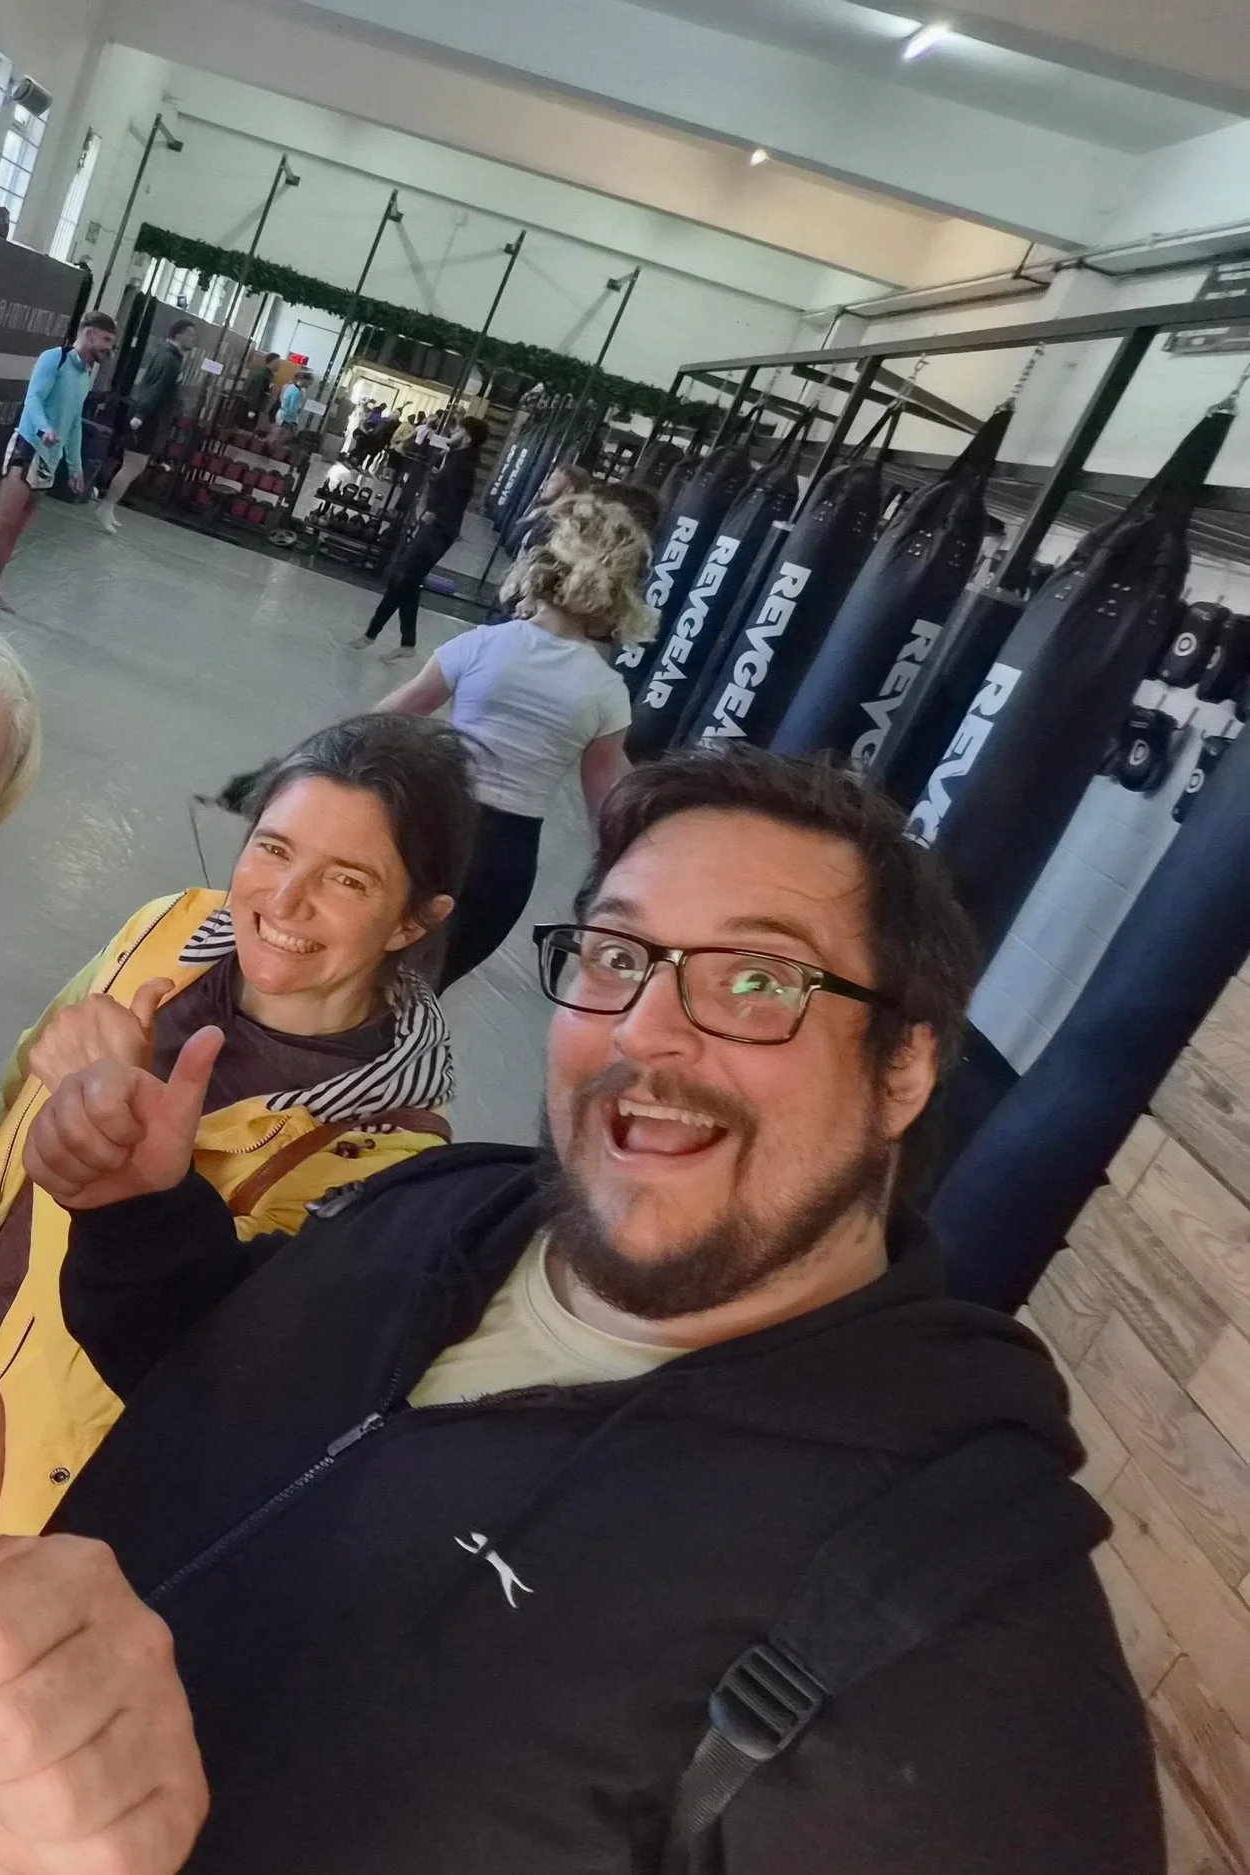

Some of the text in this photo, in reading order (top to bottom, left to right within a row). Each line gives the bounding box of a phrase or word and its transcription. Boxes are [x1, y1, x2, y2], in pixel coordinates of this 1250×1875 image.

[643, 535, 741, 709] REVGEAR
[702, 561, 813, 739] REVGEA
[850, 619, 943, 772] REVG
[903, 662, 1023, 848] REVG
